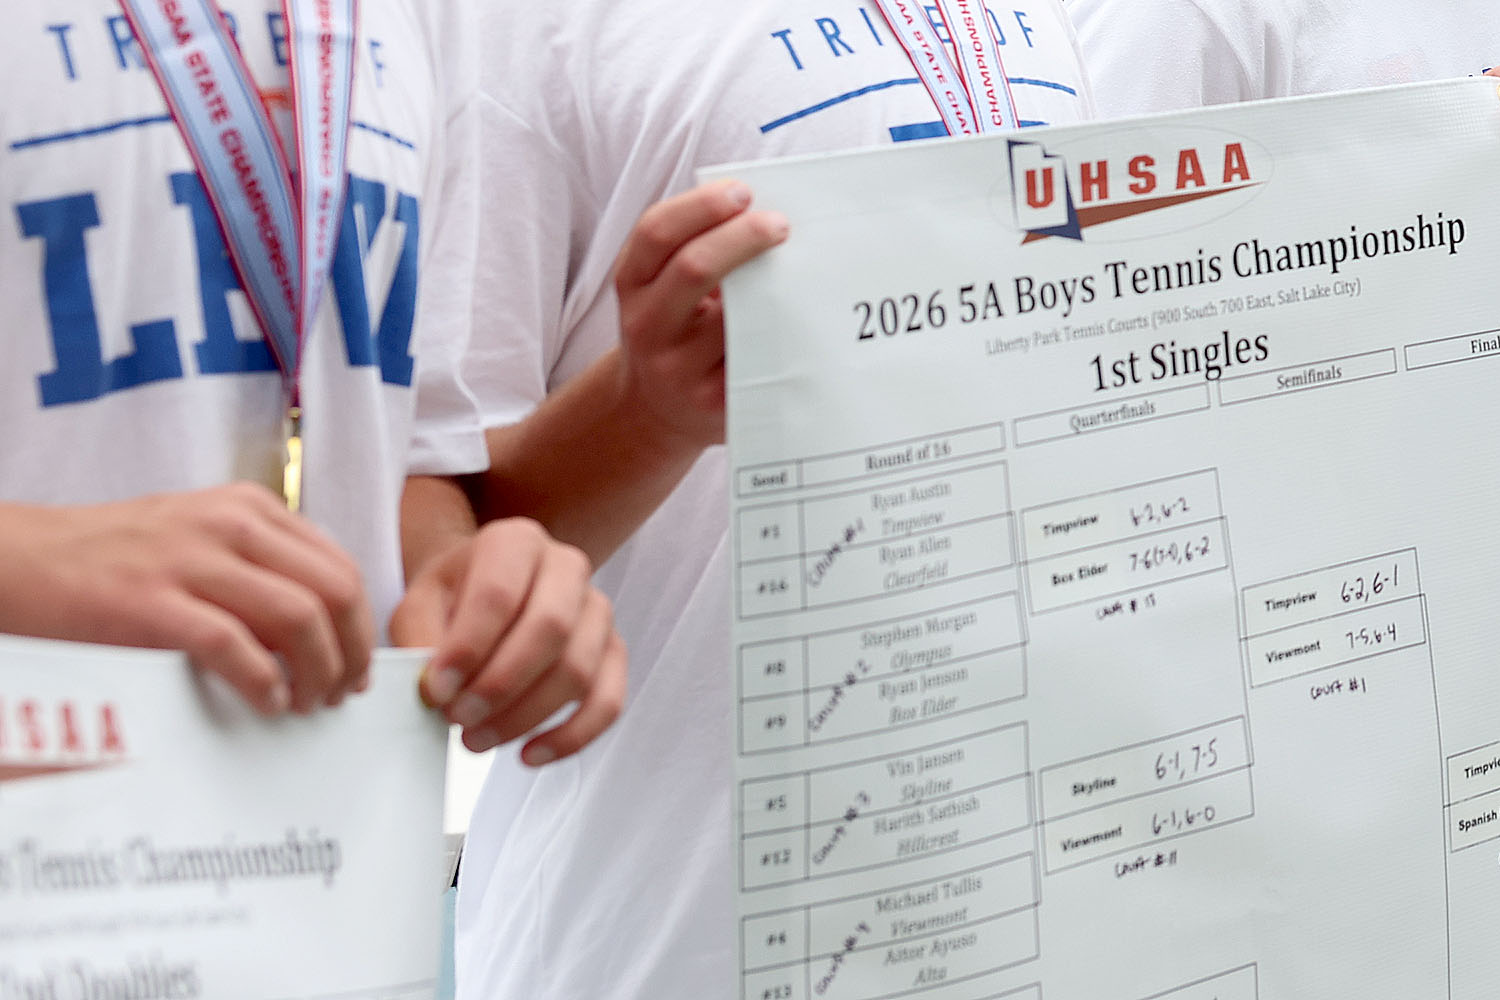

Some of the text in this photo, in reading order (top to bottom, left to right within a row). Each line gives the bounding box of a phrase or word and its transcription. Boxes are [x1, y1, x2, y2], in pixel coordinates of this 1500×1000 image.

[771, 4, 955, 71] TRIE
[912, 29, 948, 84] STATE
[1025, 142, 1251, 209] UHSAA
[852, 211, 1466, 341] 2026 5A Boys Tennis Championship
[1034, 329, 1062, 347] Park
[1064, 321, 1105, 341] Tennis
[1108, 315, 1148, 335] Courts
[1151, 309, 1181, 332] (900
[1183, 301, 1218, 321] South
[1219, 297, 1244, 315] 700
[1277, 287, 1301, 306] Salt
[1302, 283, 1332, 302] Lake
[1333, 277, 1362, 297] City)
[1089, 330, 1270, 392] 1st Singles
[1276, 364, 1343, 391] Semifinals
[1068, 400, 1157, 434] Quarterfinals
[864, 449, 913, 471] Round
[917, 445, 932, 463] of
[1265, 591, 1318, 613] Timpview
[1265, 640, 1322, 664] Viewmont
[1071, 776, 1118, 797] Skyline
[1458, 811, 1498, 833] Spanish
[1060, 826, 1123, 853] Viewmont
